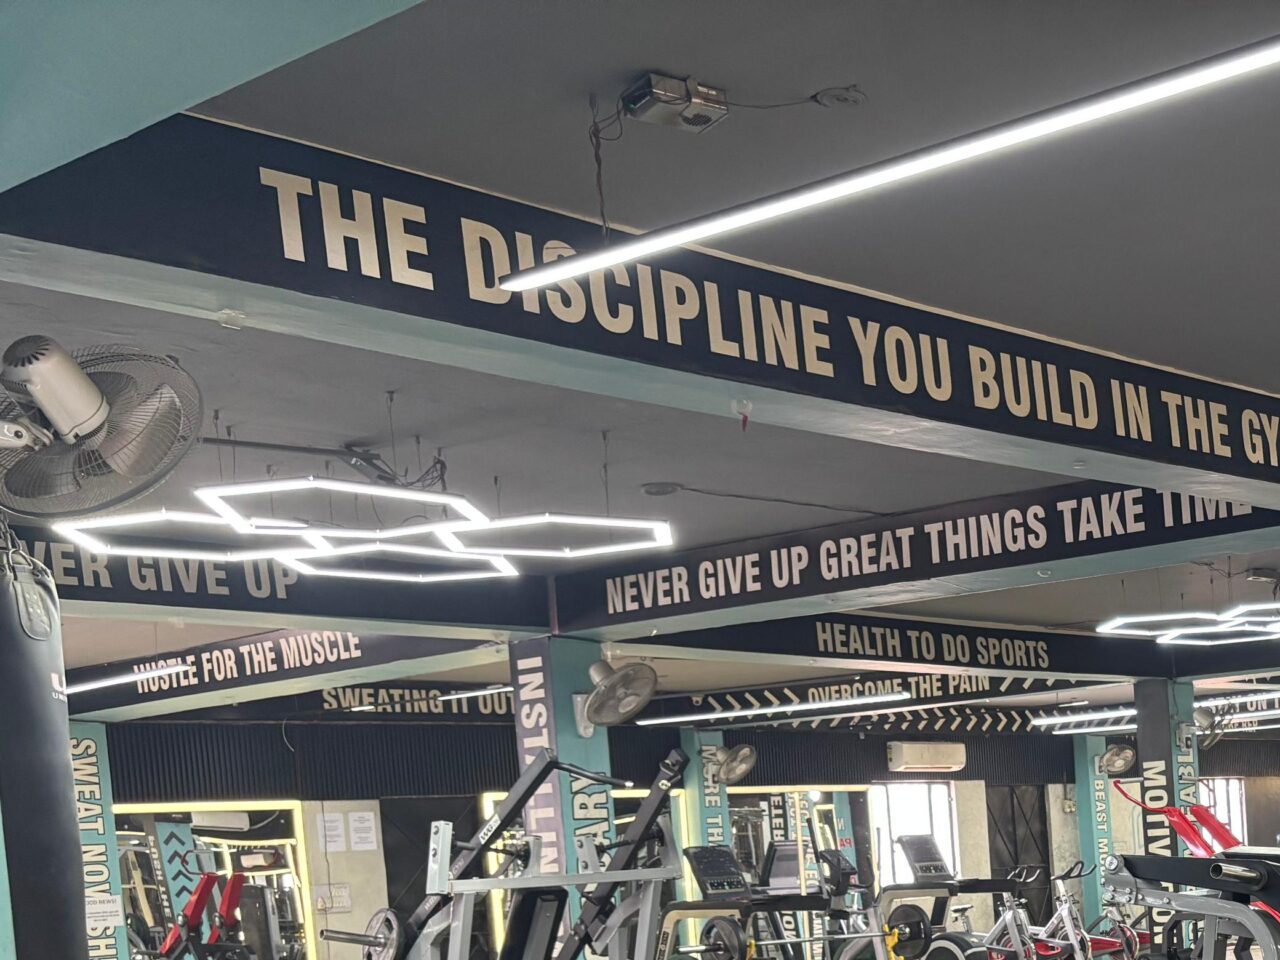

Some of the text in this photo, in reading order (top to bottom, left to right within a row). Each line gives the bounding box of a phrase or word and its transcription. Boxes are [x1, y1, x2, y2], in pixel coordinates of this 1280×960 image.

[259, 166, 434, 291] THE
[460, 216, 835, 378] DISCIPLINE
[847, 315, 952, 401] YOU
[968, 345, 1098, 430] BUILD
[1110, 379, 1152, 442] IN
[1160, 389, 1232, 458] THE
[127, 555, 229, 596] GIVE
[244, 559, 299, 600] UP
[606, 568, 690, 614] NEVER
[698, 553, 761, 599] GIVE
[770, 545, 809, 588] UP
[821, 528, 915, 581] GREAT
[925, 508, 1047, 563] THINGS
[1056, 488, 1145, 543] TAKE
[133, 631, 362, 694] HUSTLE FOR THE MUSCLE
[816, 621, 1049, 669] HEALTH TO DO SPORTS
[323, 687, 443, 714] SWEATING
[449, 688, 468, 714] IT
[808, 672, 990, 704] OVERCOME THE PAIN
[1246, 692, 1268, 711] ON
[70, 737, 106, 836] SWEAT
[516, 656, 561, 876] INSTLLIN
[1094, 779, 1109, 833] BEAST
[1142, 760, 1176, 945] MOTIVON
